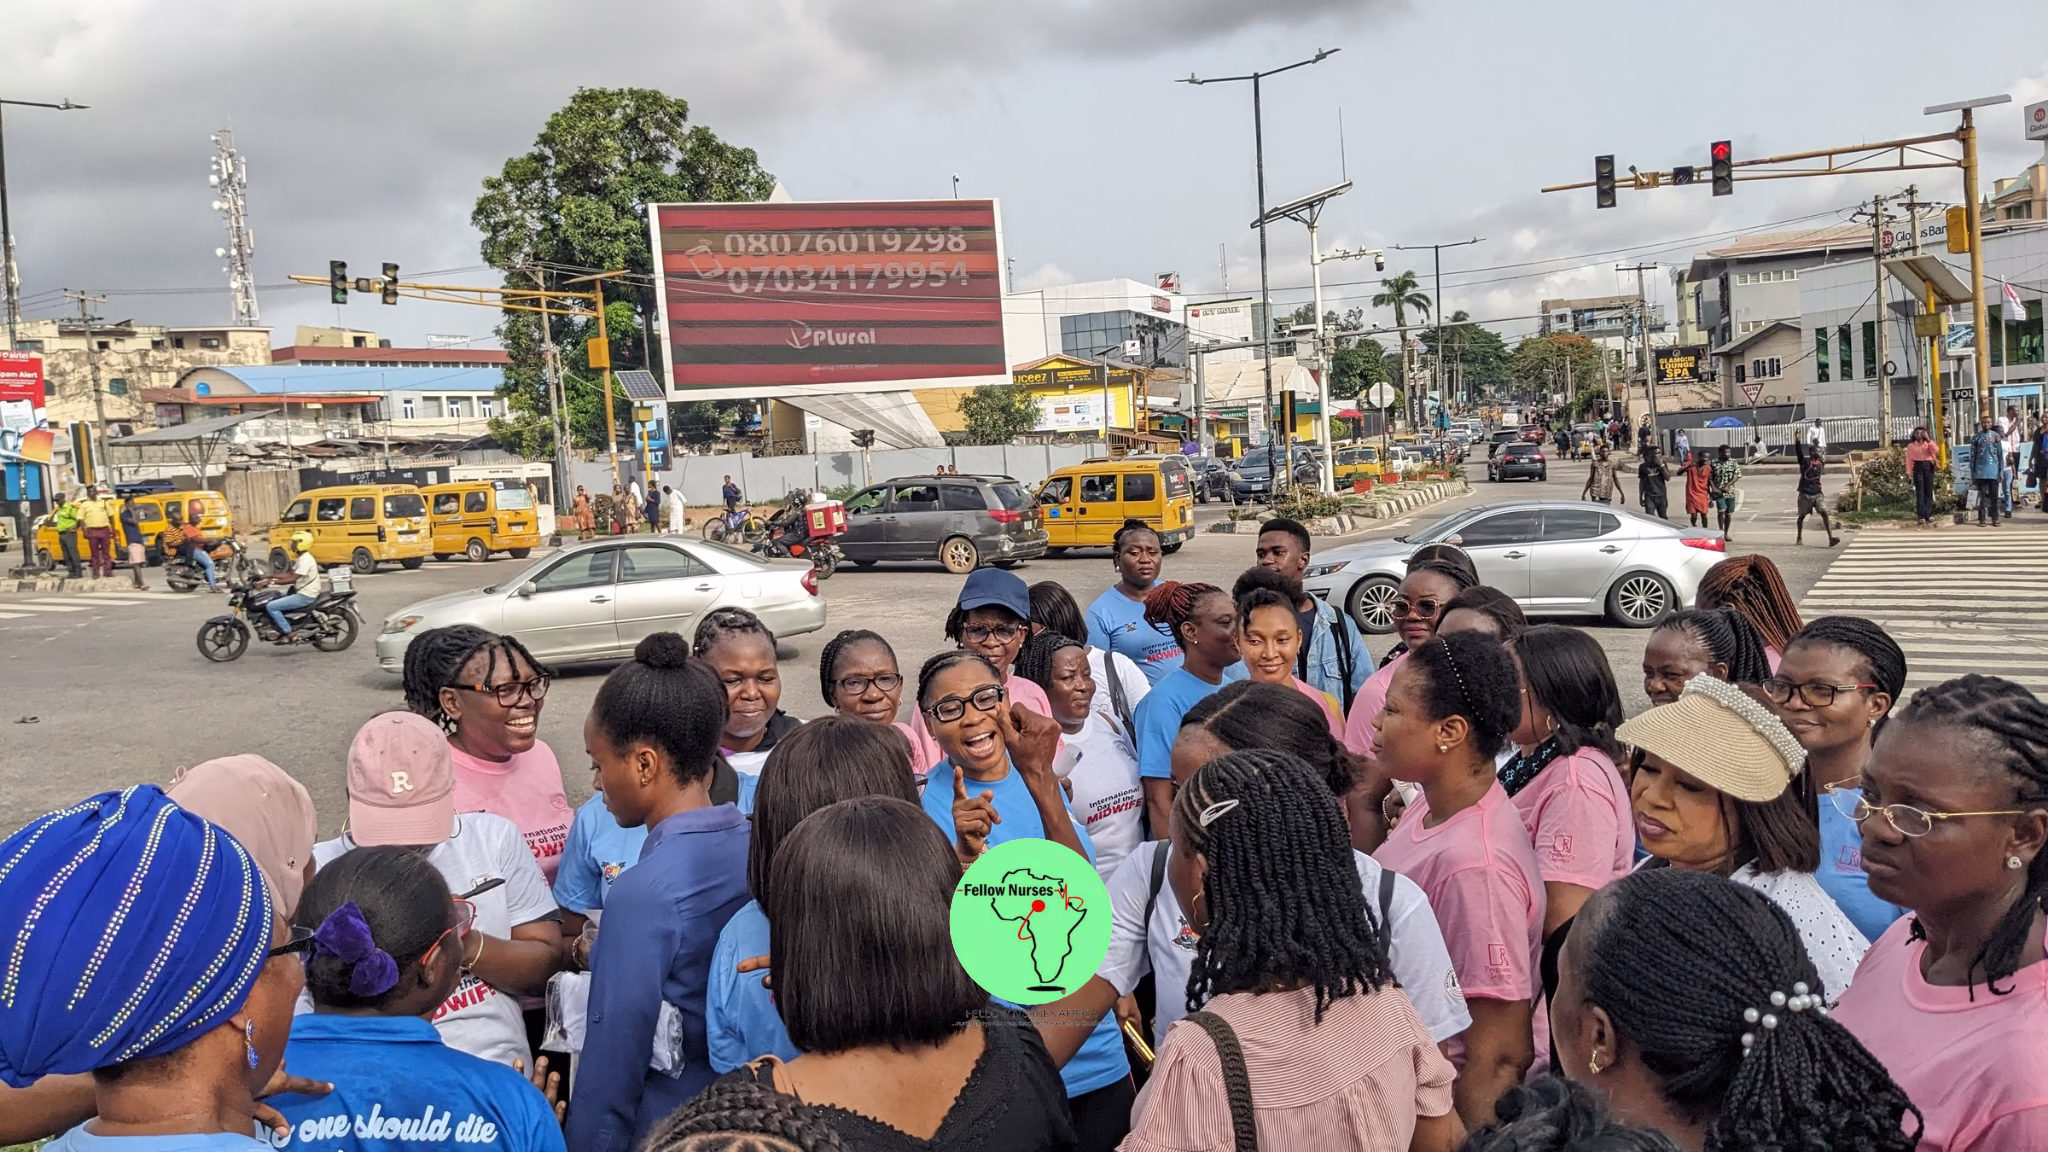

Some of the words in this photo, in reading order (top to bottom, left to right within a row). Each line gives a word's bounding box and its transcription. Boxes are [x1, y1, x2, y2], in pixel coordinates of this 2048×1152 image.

[724, 227, 967, 256] 08076019298
[728, 261, 969, 293] 07034179954
[813, 328, 876, 346] Plural
[19, 371, 38, 379] Alert
[1660, 362, 1695, 370] LOUNGE
[1666, 368, 1689, 378] SPA
[350, 472, 370, 482] POST
[1147, 648, 1184, 662] MIDWIF
[392, 771, 413, 792] R
[1089, 786, 1140, 808] International
[1097, 803, 1111, 812] Day
[1123, 794, 1134, 802] the
[1086, 797, 1143, 824] MIDWIFE
[523, 823, 568, 838] rnational
[538, 835, 548, 844] of
[550, 832, 567, 842] the
[460, 976, 479, 990] the
[433, 983, 497, 1020] DWIF
[299, 1114, 351, 1143] one
[354, 1103, 451, 1142] should
[454, 1113, 498, 1143] die
